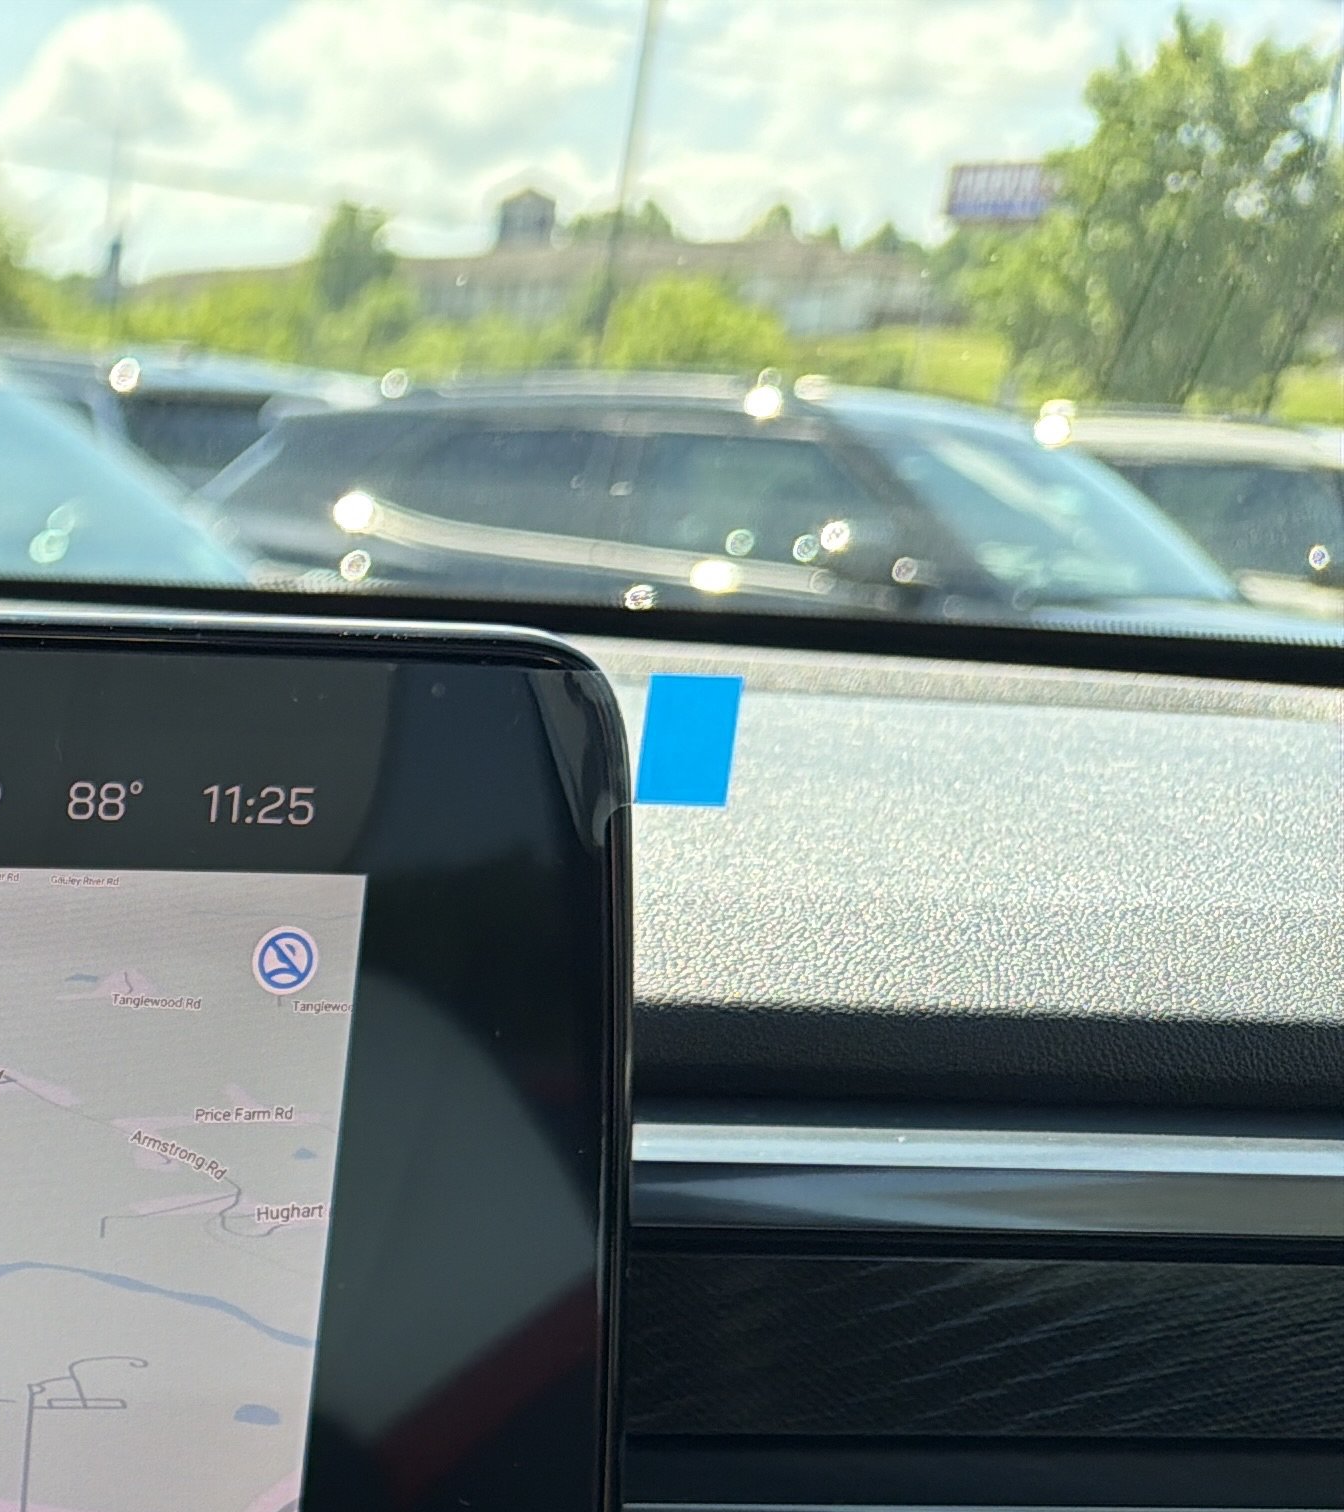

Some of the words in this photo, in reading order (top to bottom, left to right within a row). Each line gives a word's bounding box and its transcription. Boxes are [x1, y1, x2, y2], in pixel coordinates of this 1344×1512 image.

[67, 780, 143, 821] 88°
[202, 785, 315, 825] 11:25
[112, 994, 183, 1010] Tanglewood
[185, 999, 202, 1010] Rd
[195, 1107, 232, 1122] Price
[235, 1108, 271, 1120] Farm
[275, 1107, 294, 1120] Rd
[131, 1130, 207, 1168] Armstrong
[207, 1160, 228, 1180] Rd
[256, 1204, 325, 1224] Hughart
